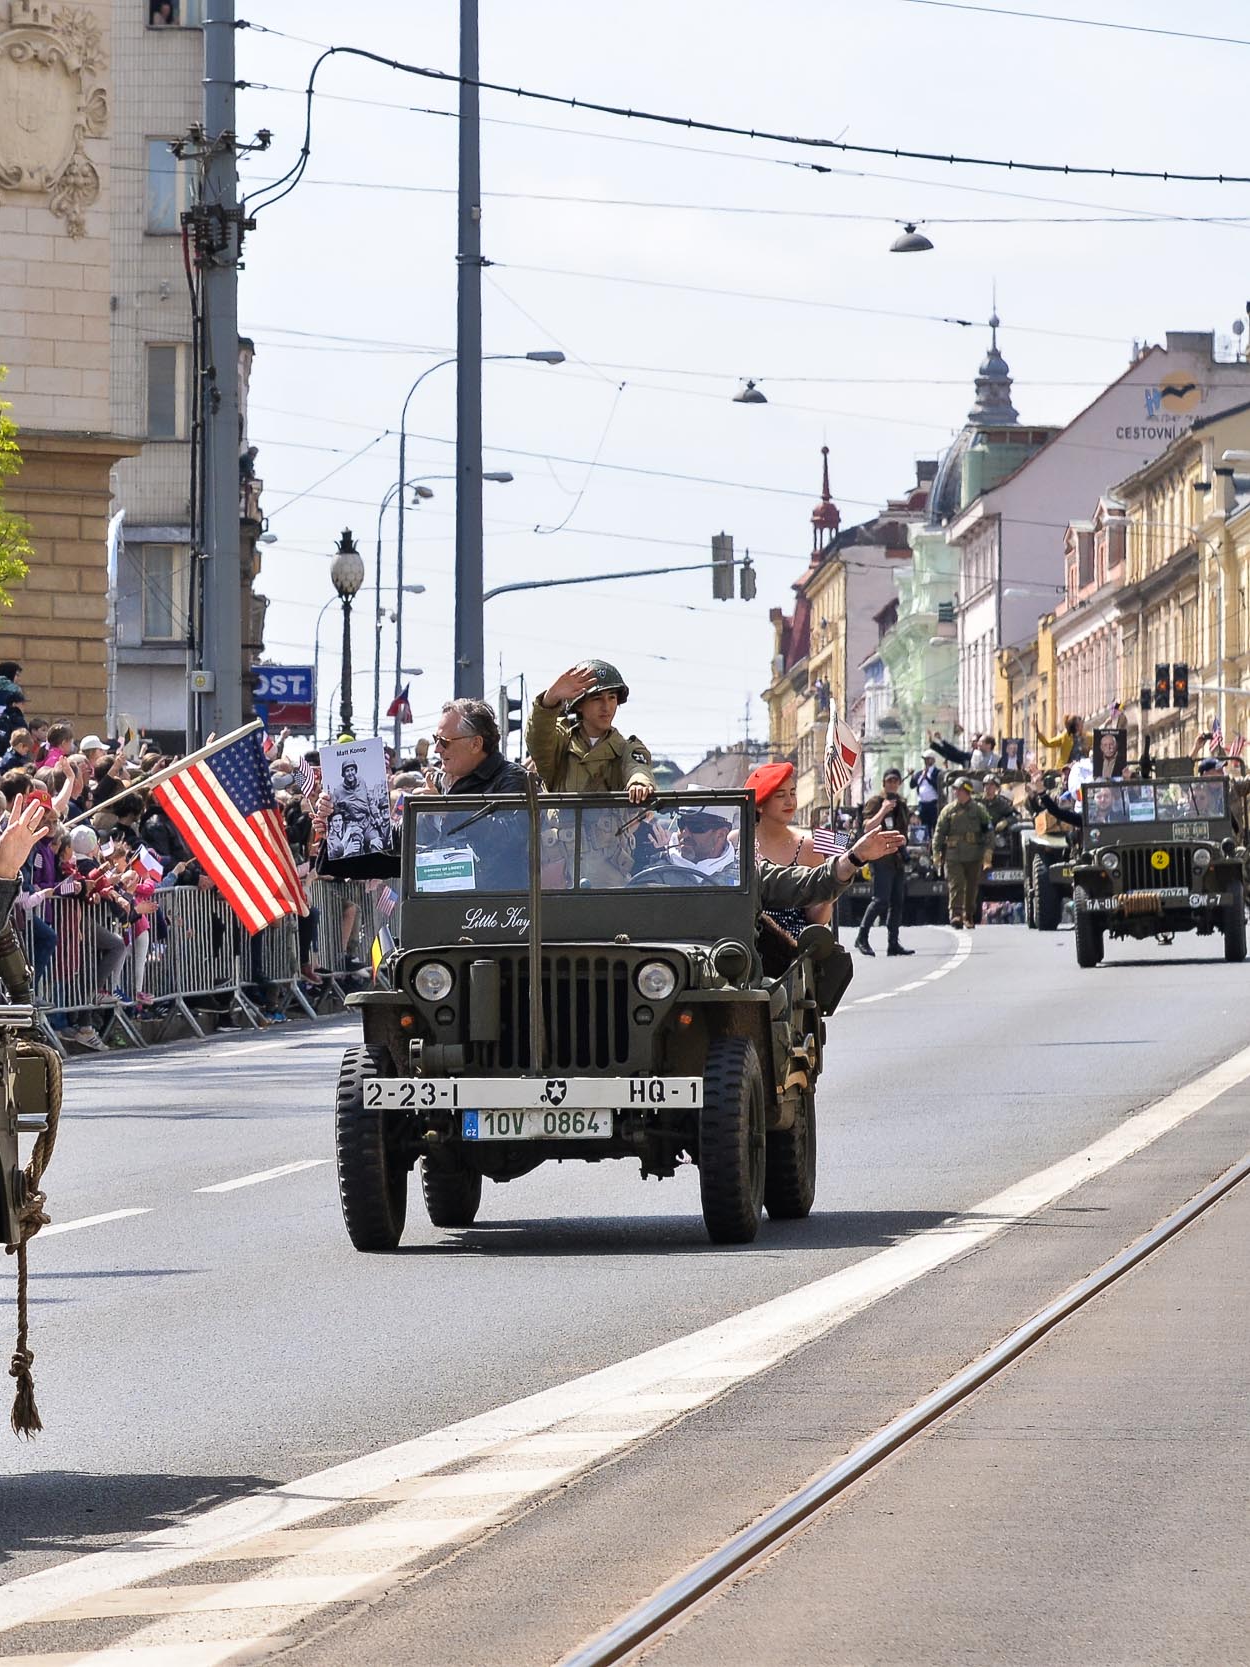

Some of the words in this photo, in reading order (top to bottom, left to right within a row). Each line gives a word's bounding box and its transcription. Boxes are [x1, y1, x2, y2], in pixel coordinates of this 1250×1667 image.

[1116, 424, 1176, 439] CESTOVNÍ
[349, 747, 367, 755] Konop
[461, 907, 498, 930] Little
[500, 906, 531, 936] Kay
[484, 1111, 524, 1136] 10V
[543, 1110, 600, 1135] 0864
[465, 1128, 477, 1137] CZ
